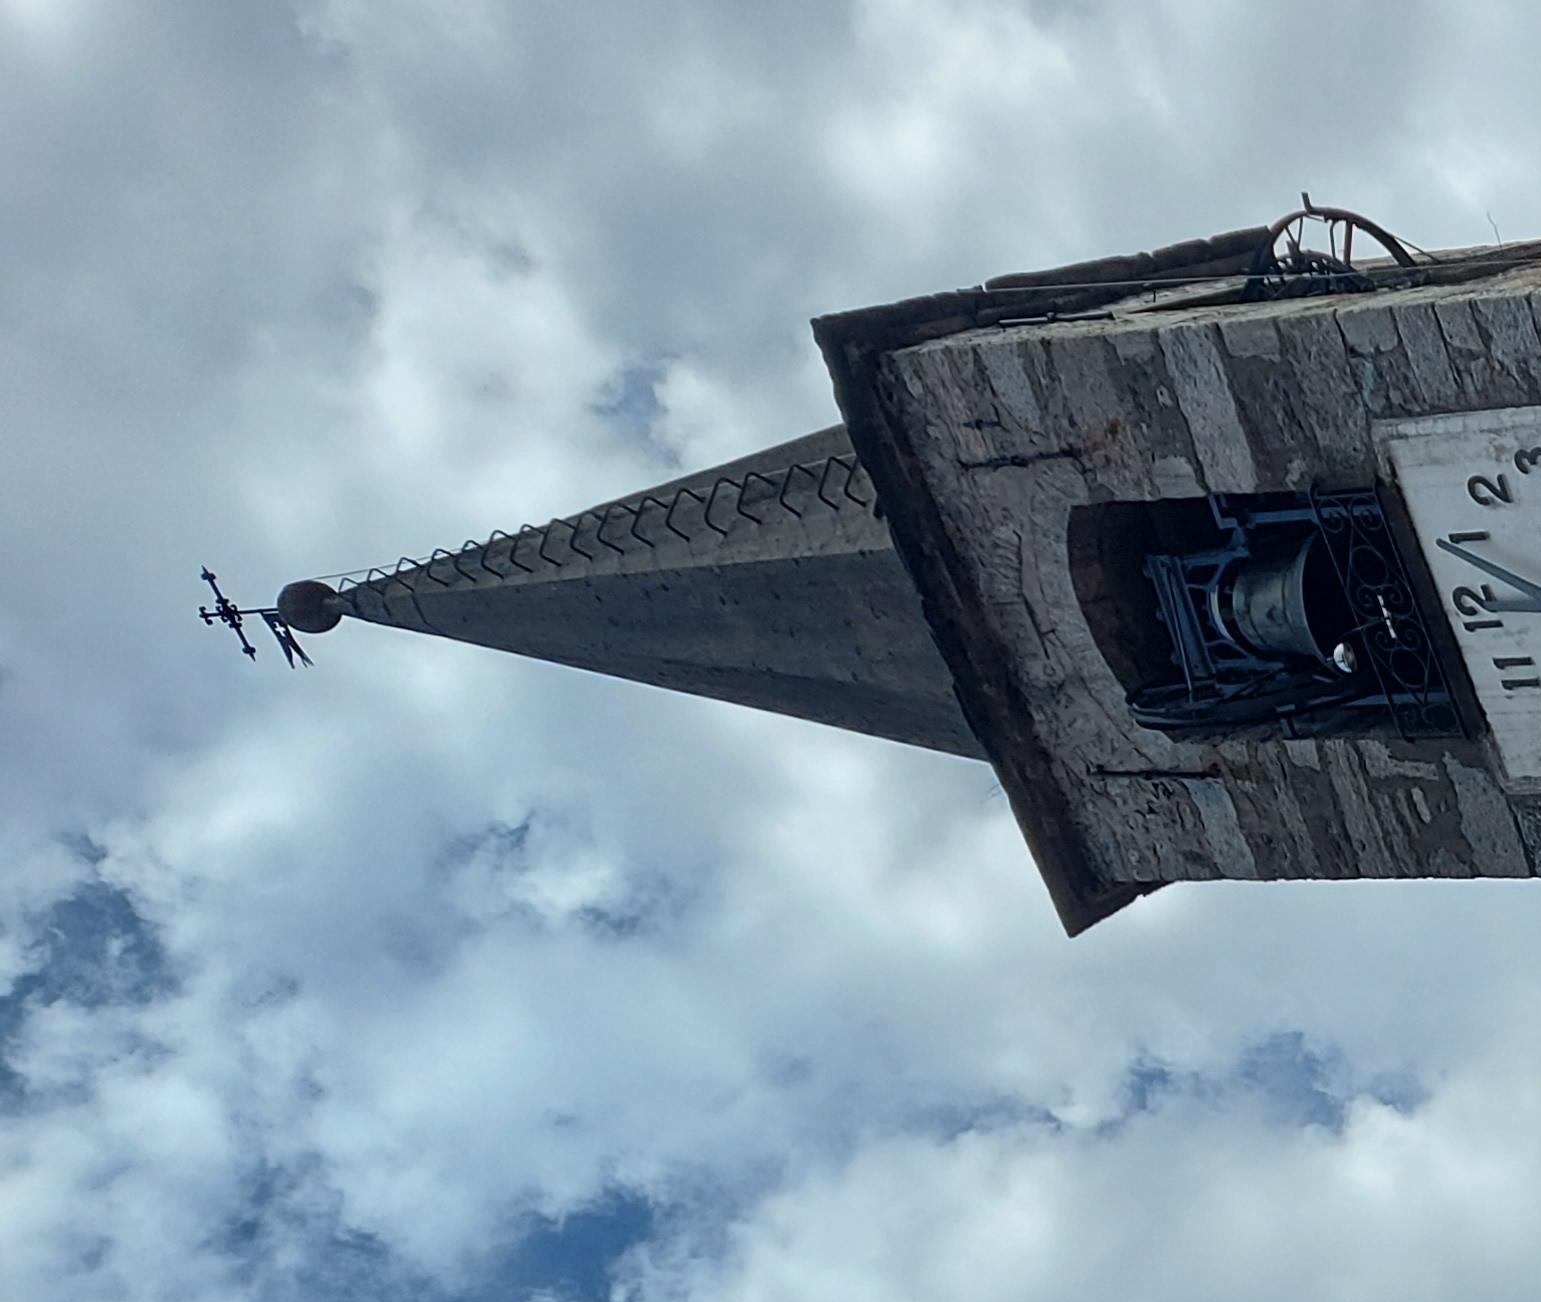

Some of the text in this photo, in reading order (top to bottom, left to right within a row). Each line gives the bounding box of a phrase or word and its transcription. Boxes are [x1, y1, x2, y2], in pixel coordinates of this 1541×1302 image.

[1467, 472, 1513, 507] 2
[1448, 530, 1490, 544] 1
[1452, 584, 1504, 633] 12
[1492, 655, 1541, 690] 11
